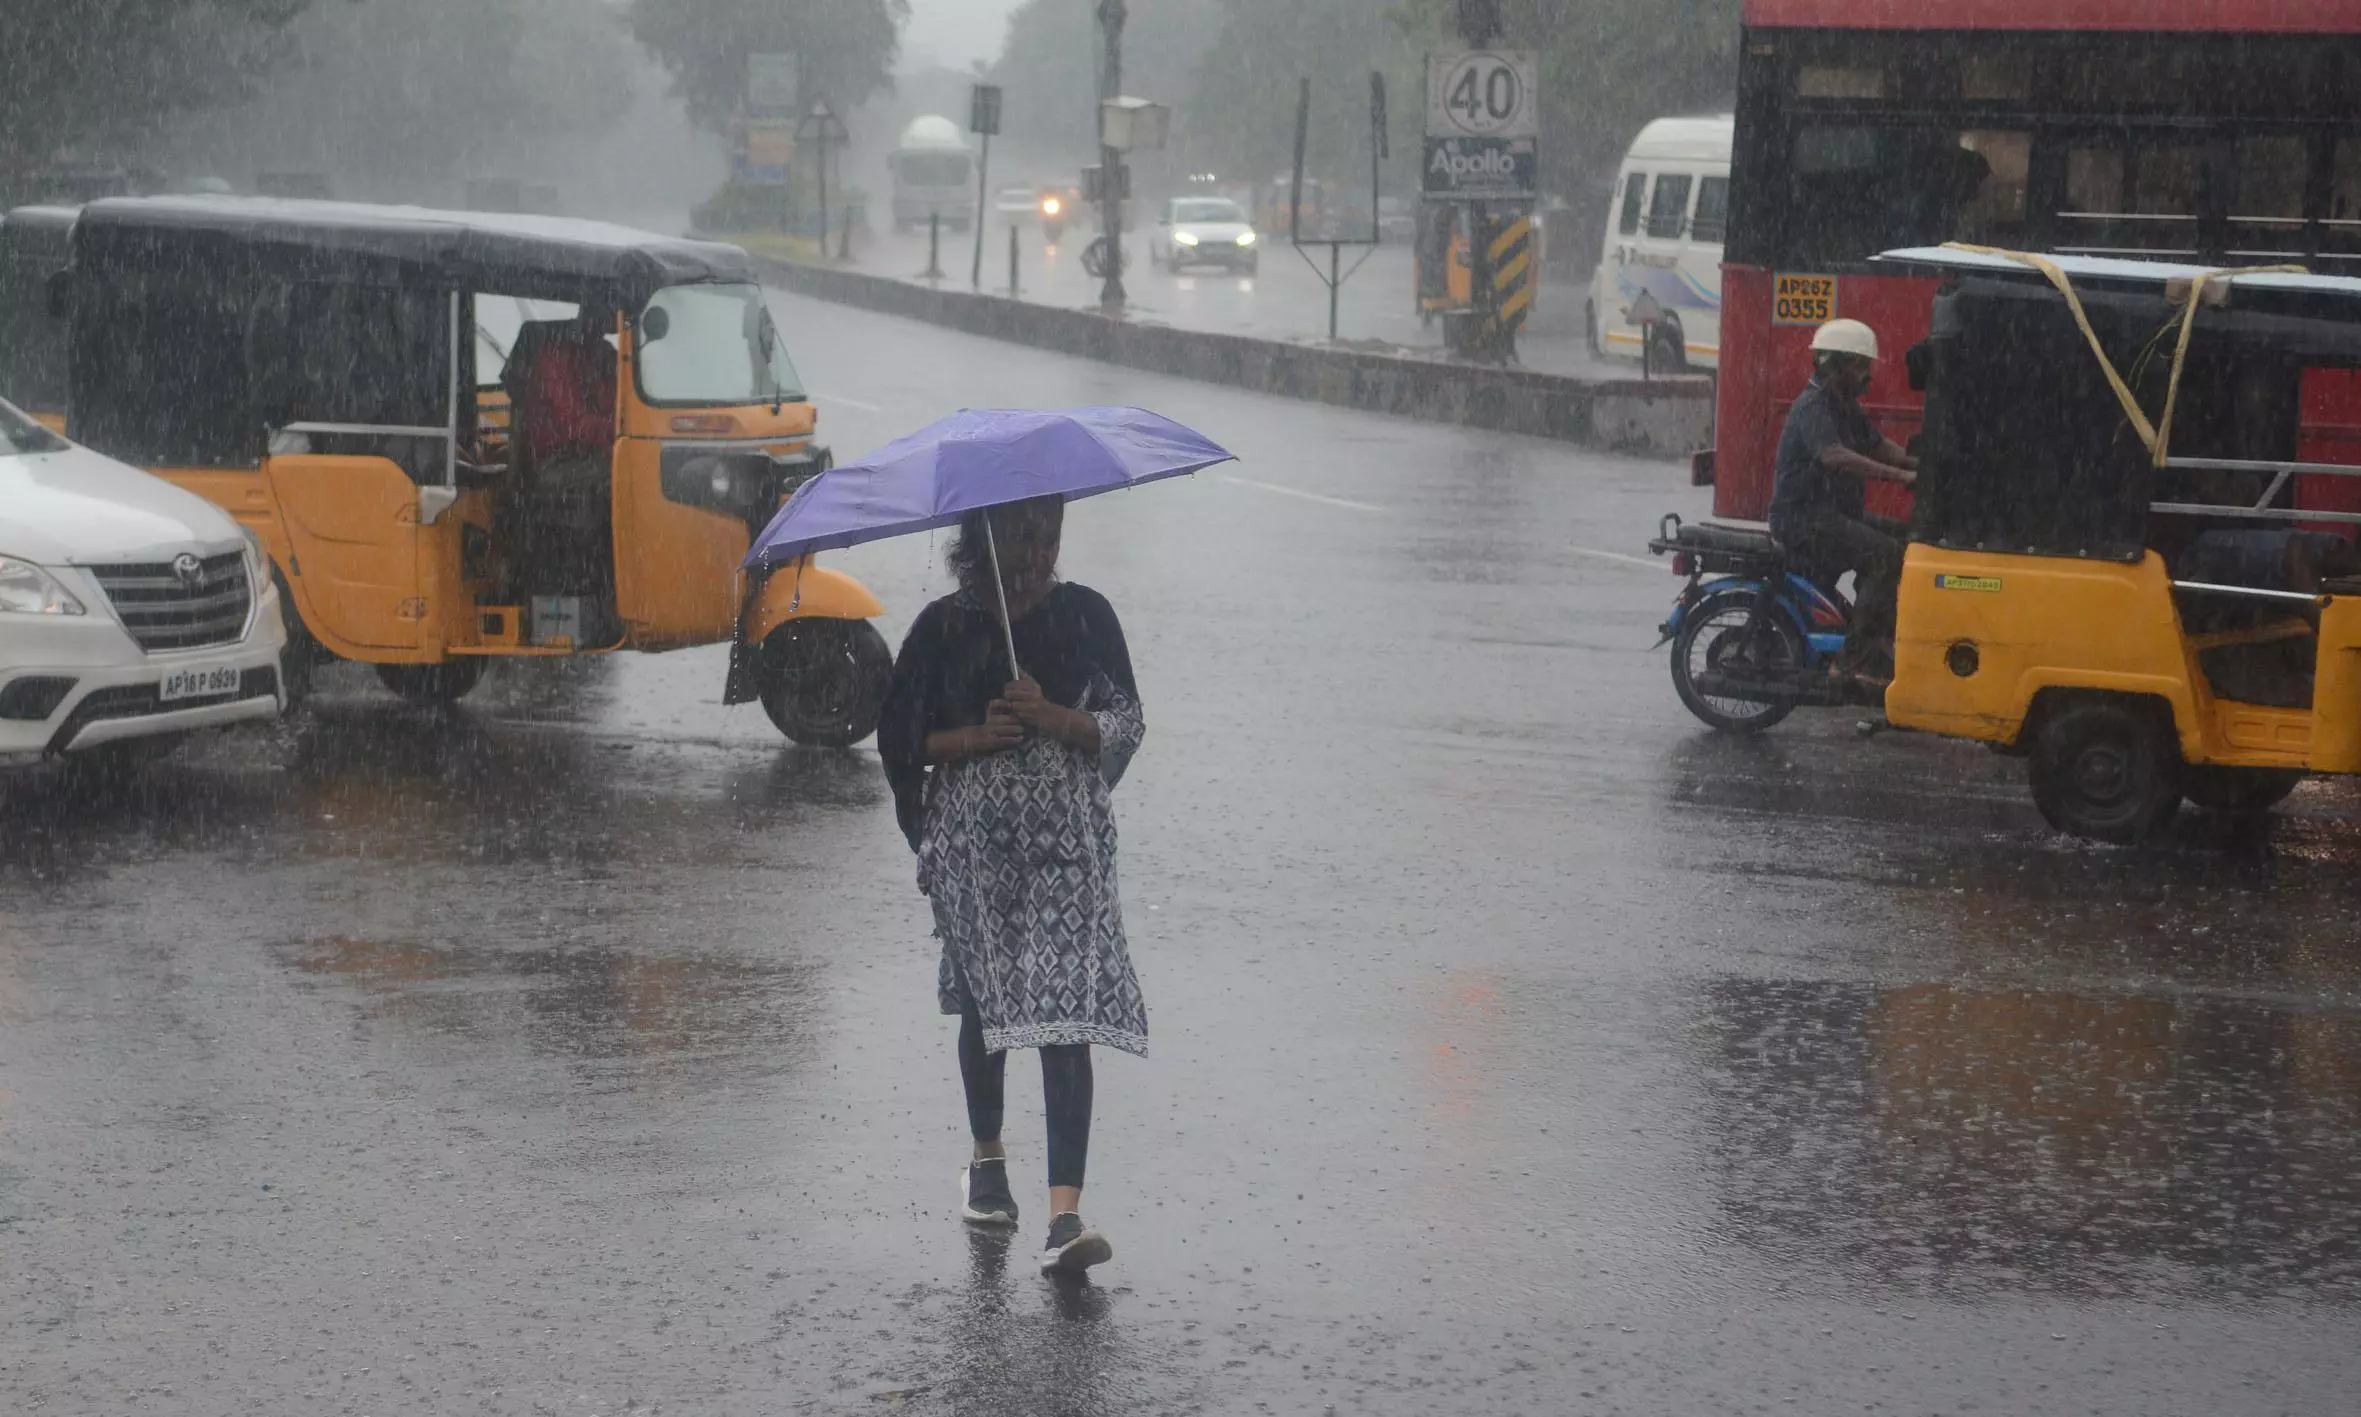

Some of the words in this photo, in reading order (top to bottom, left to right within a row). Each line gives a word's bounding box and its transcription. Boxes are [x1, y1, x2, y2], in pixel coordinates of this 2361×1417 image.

[1450, 66, 1515, 121] 40
[1430, 147, 1515, 186] Apollo
[1778, 298, 1828, 320] 0355
